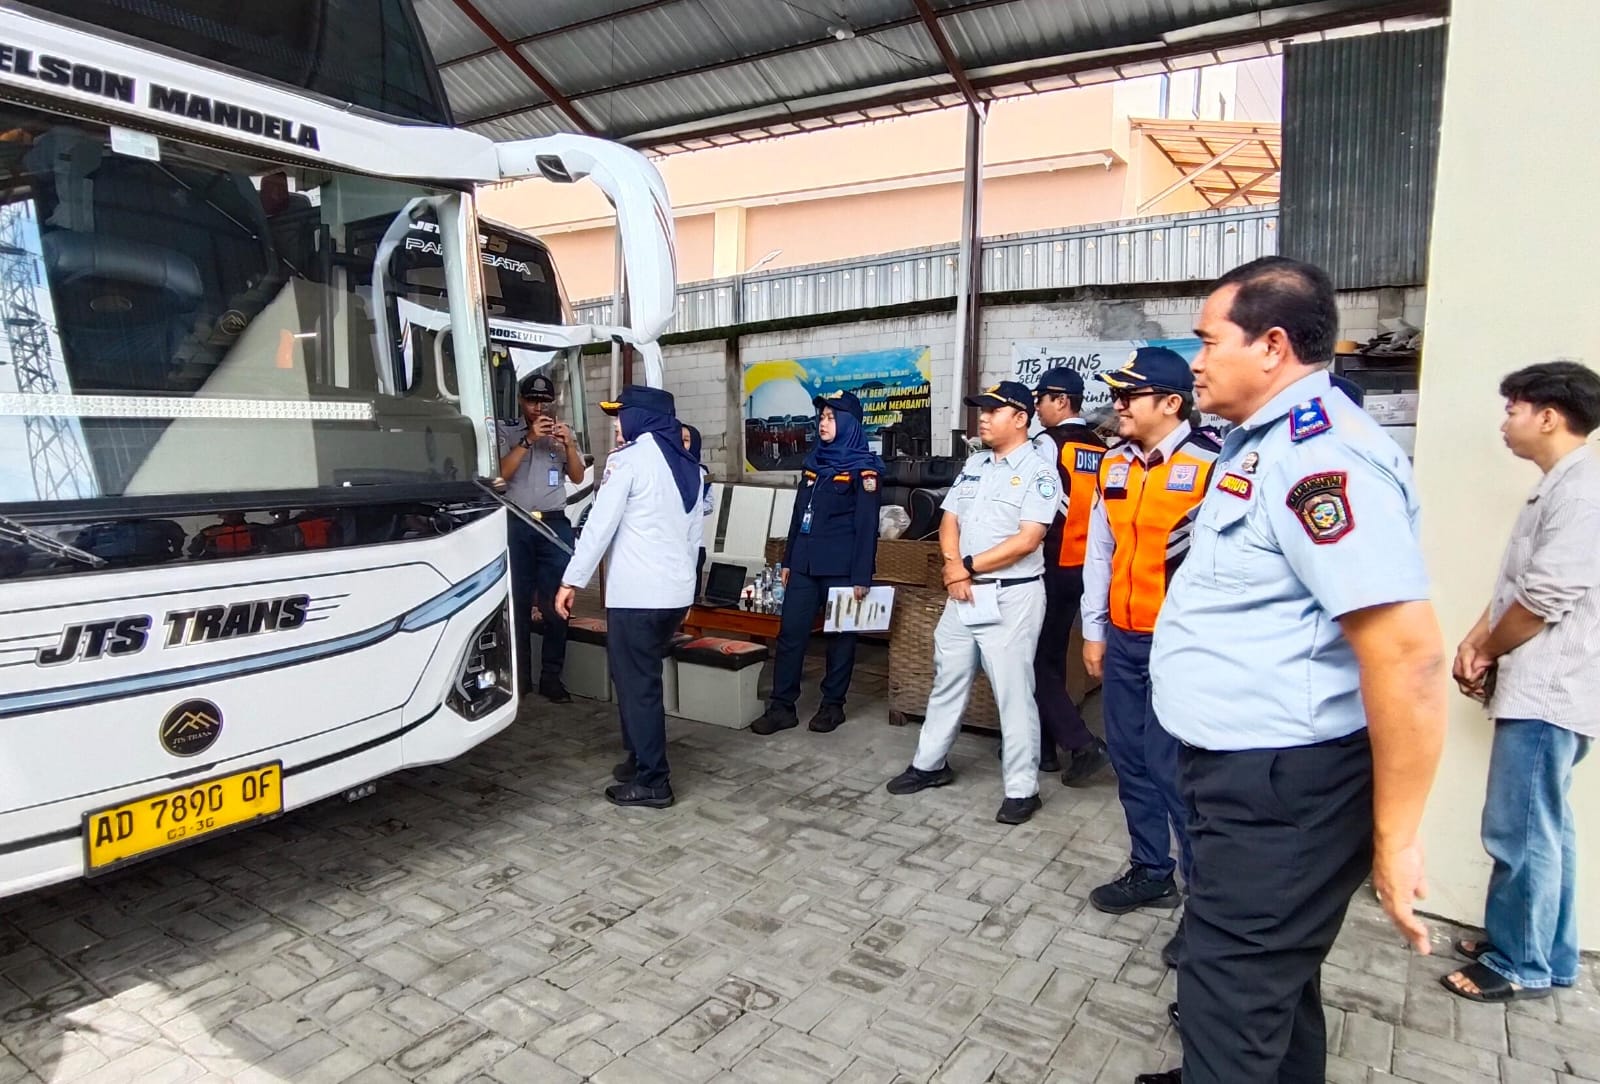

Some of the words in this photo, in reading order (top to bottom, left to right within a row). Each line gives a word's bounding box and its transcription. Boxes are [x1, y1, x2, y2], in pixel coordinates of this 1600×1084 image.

[149, 82, 321, 151] MANDELA
[1015, 358, 1042, 375] JTS
[1046, 353, 1102, 371] TRANS
[869, 384, 929, 398] BERPENAMPILAN
[863, 401, 887, 412] DALAM
[889, 398, 930, 410] MEMBANTU
[862, 413, 903, 425] PELANGGAN
[1076, 451, 1101, 471] DISH
[36, 614, 153, 668] JTS
[163, 594, 310, 649] TRANS
[94, 810, 134, 848] AD
[151, 785, 224, 830] 7890
[241, 769, 273, 803] OF
